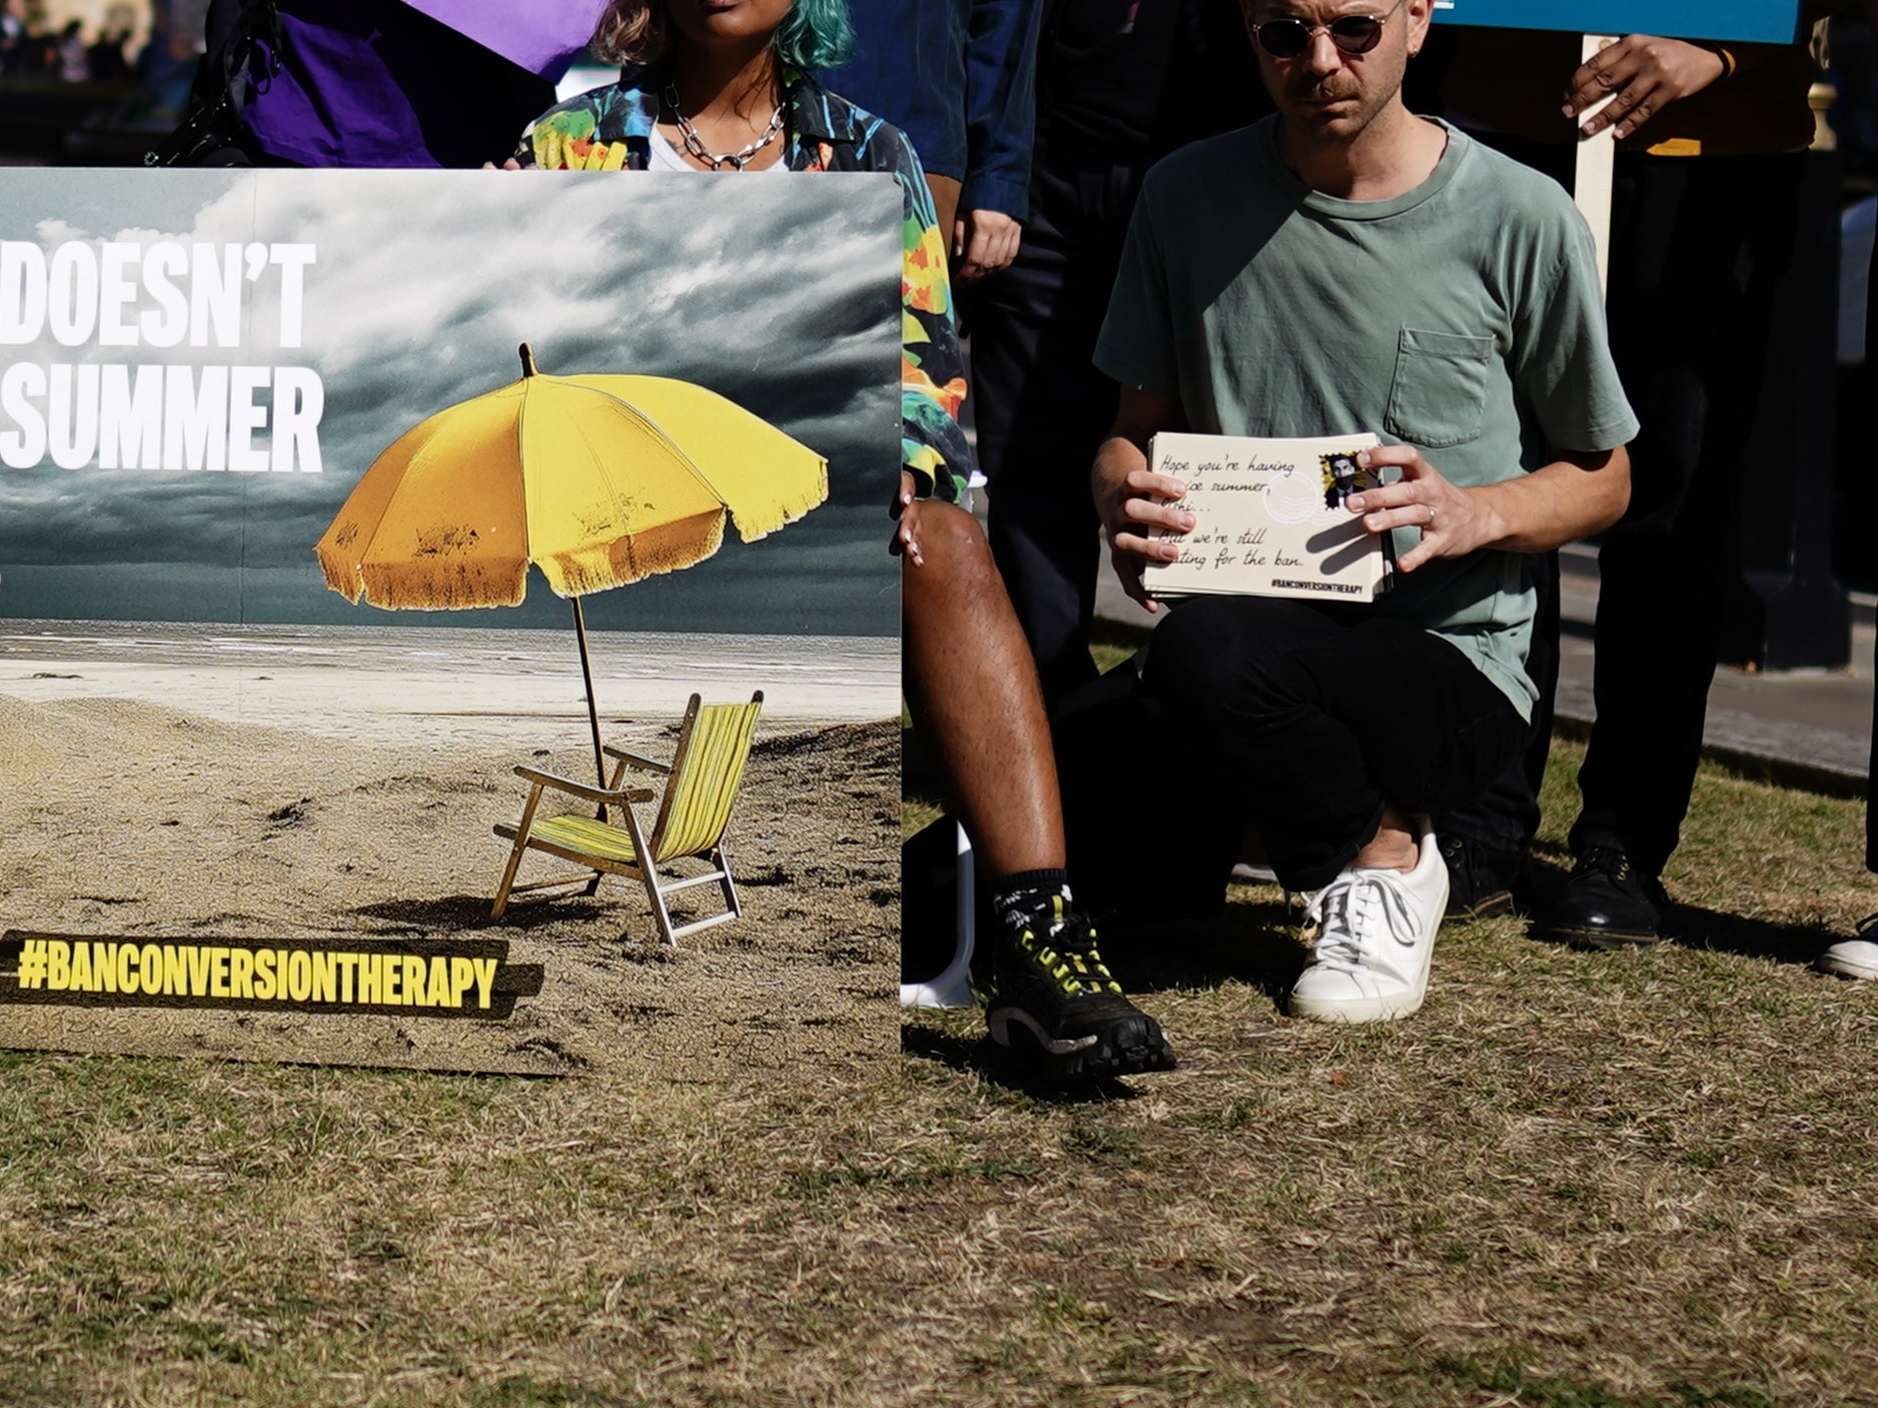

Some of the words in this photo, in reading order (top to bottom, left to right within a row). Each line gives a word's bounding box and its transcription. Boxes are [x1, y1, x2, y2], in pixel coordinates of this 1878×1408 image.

[0, 363, 324, 473] SUMMER
[1161, 455, 1190, 476] Hope
[1197, 454, 1240, 477] you're
[1247, 454, 1295, 478] having
[1211, 482, 1271, 496] summer,
[1193, 526, 1229, 544] we're
[1237, 527, 1268, 545] still
[1214, 547, 1237, 570] for
[1243, 549, 1267, 566] the
[1275, 549, 1304, 567] ban.
[1271, 578, 1364, 595] #BANCONVERSIONTHERAPY
[18, 939, 497, 1009] #BANCONVERSIONTHERAPY
